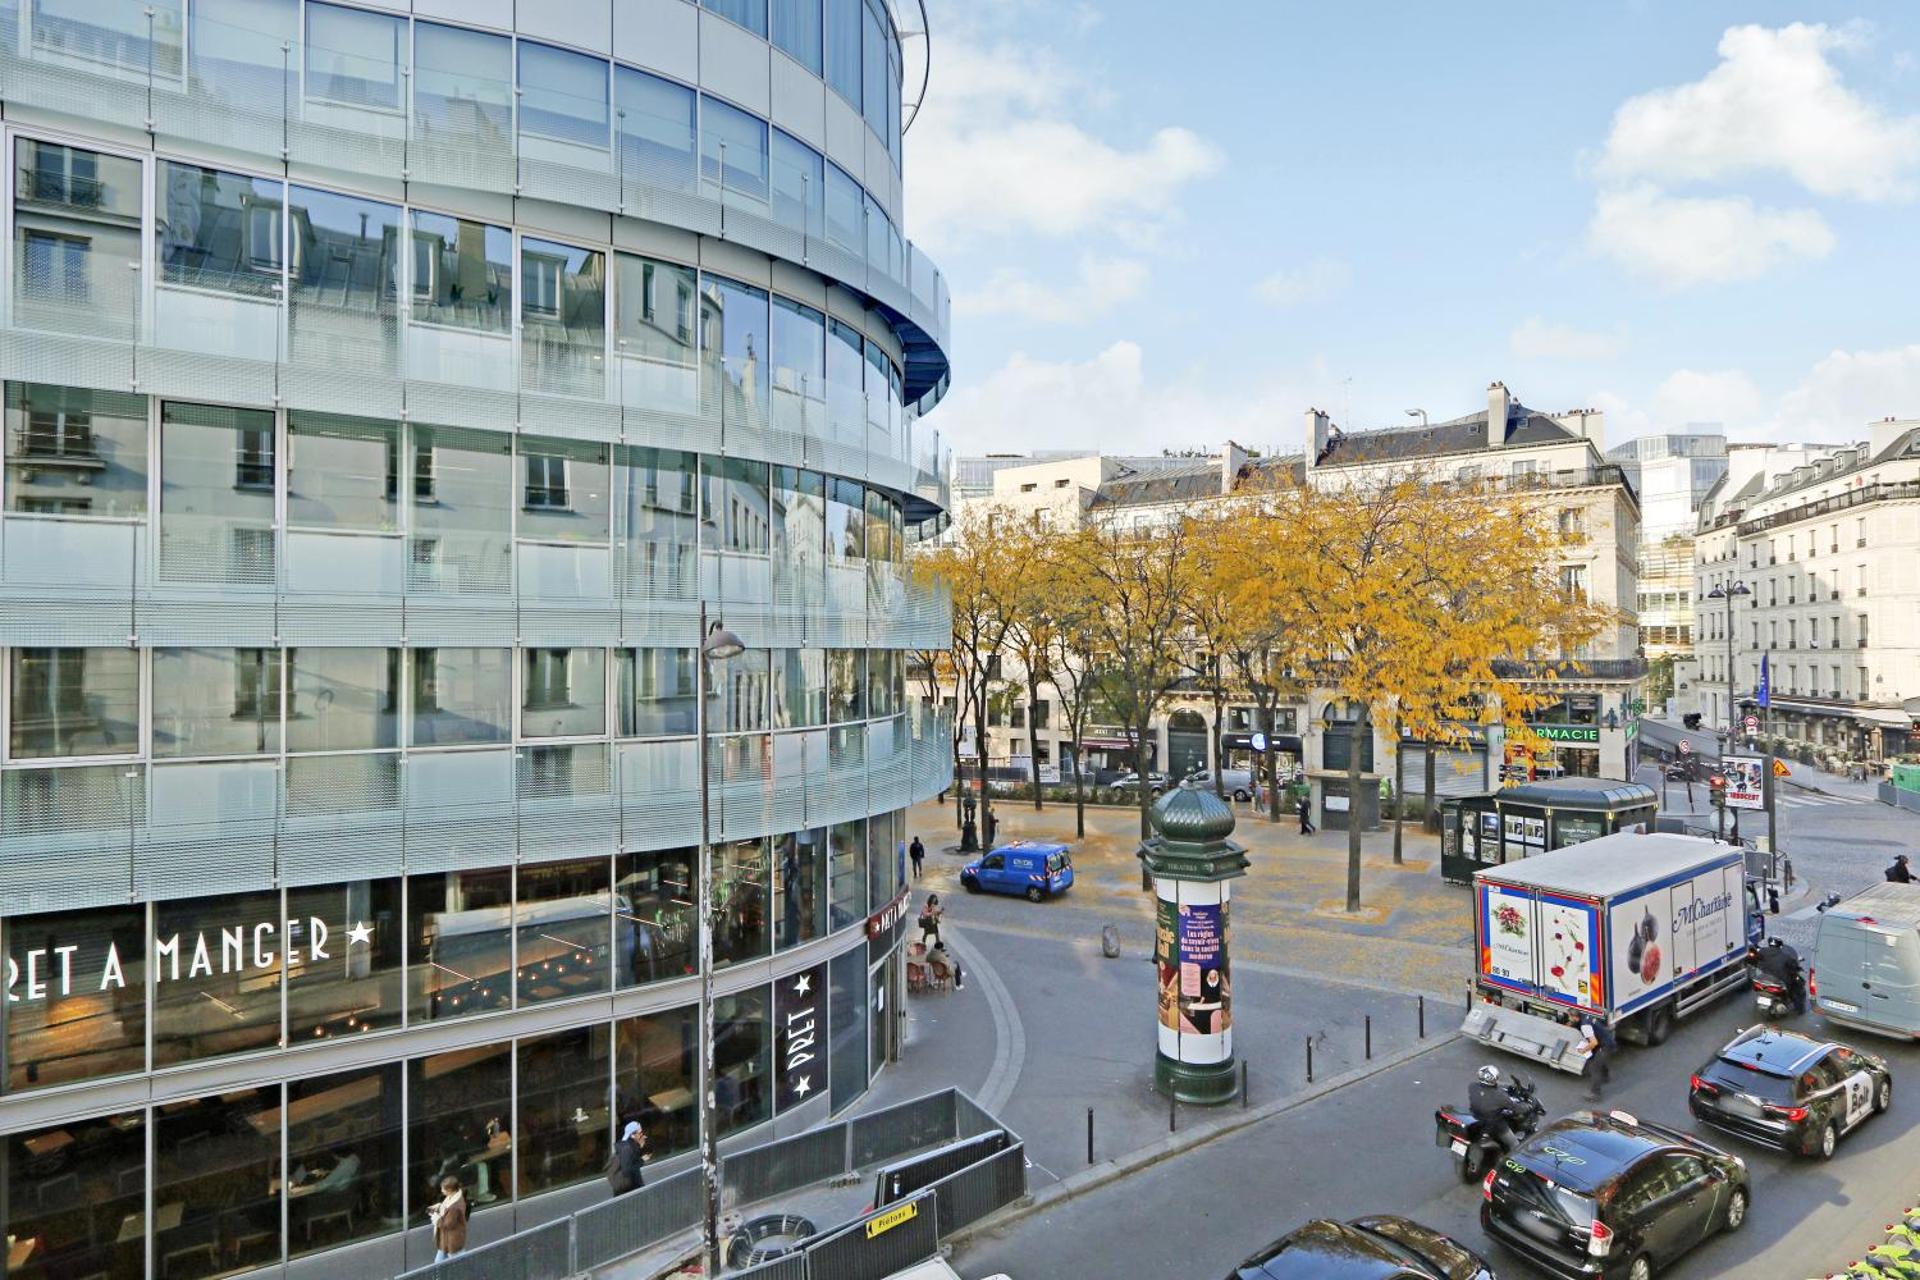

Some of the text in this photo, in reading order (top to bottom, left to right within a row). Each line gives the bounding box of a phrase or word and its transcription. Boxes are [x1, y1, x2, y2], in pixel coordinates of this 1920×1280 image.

[101, 942, 125, 990] A
[156, 917, 329, 982] MANGER
[787, 1007, 814, 1070] PRET
